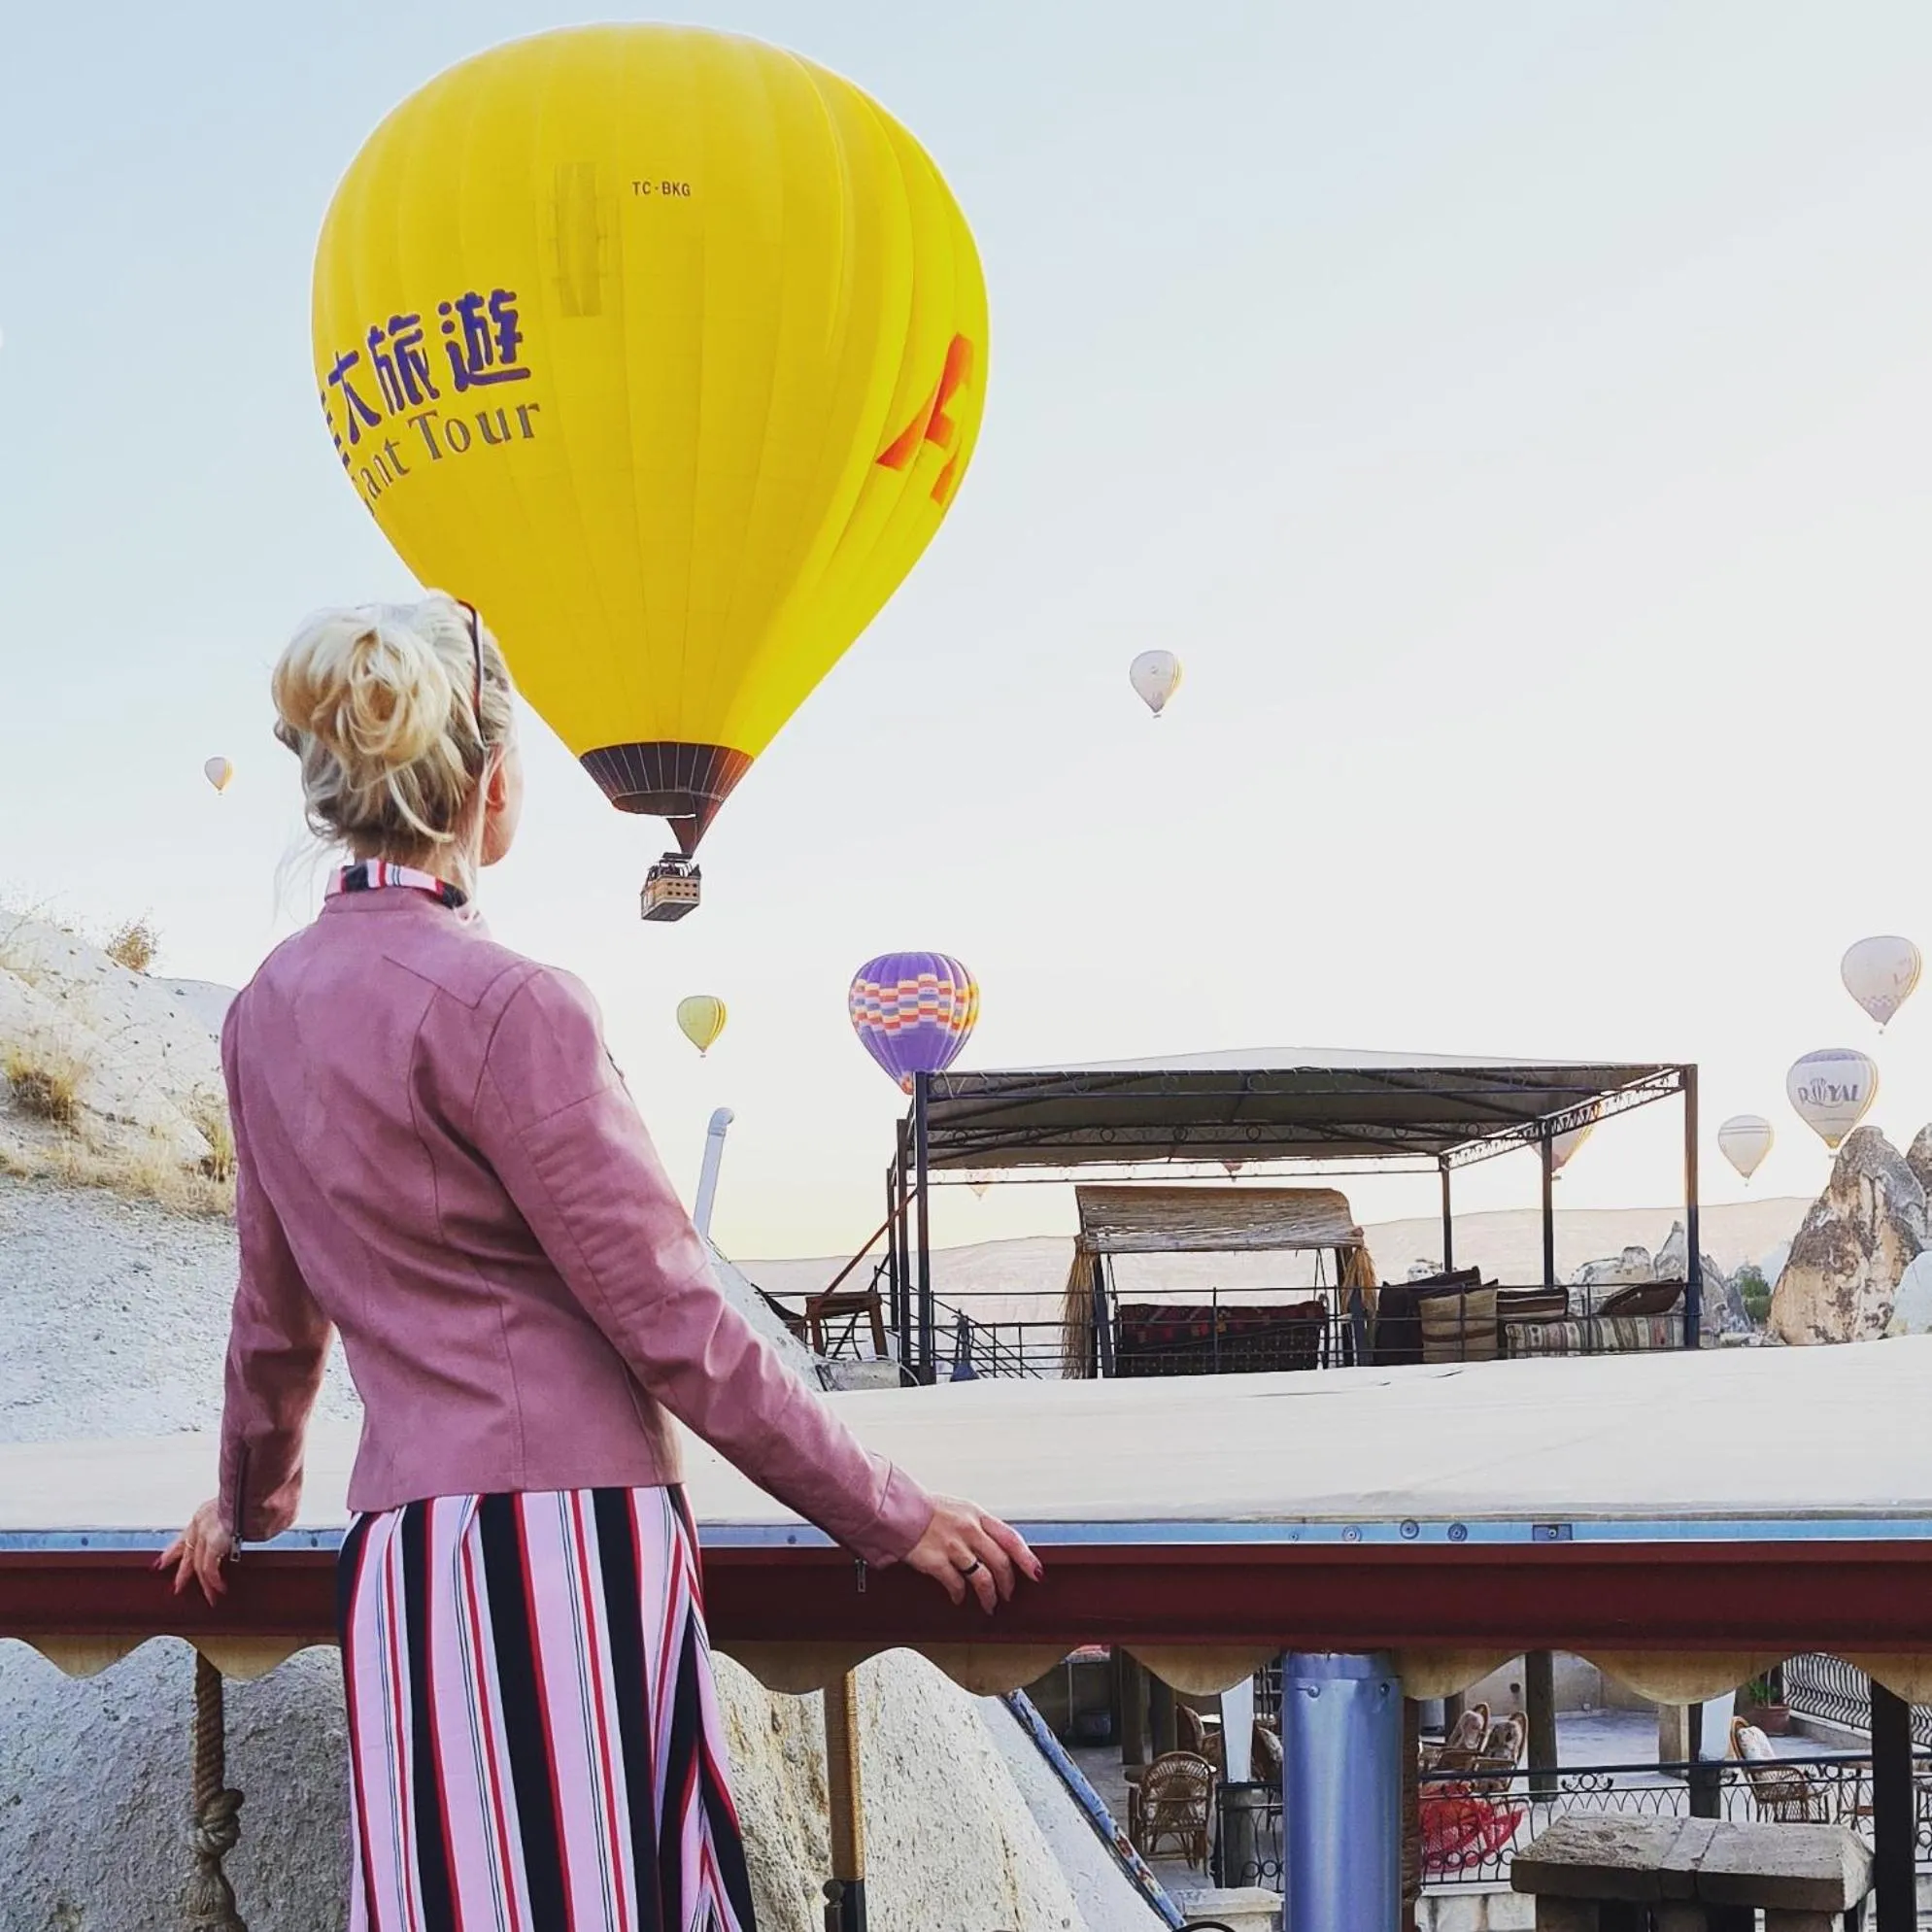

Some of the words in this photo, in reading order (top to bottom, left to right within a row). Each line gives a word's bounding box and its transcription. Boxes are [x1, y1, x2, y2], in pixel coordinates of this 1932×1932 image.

[320, 288, 531, 468] 大旅遊
[407, 402, 540, 460] Tour
